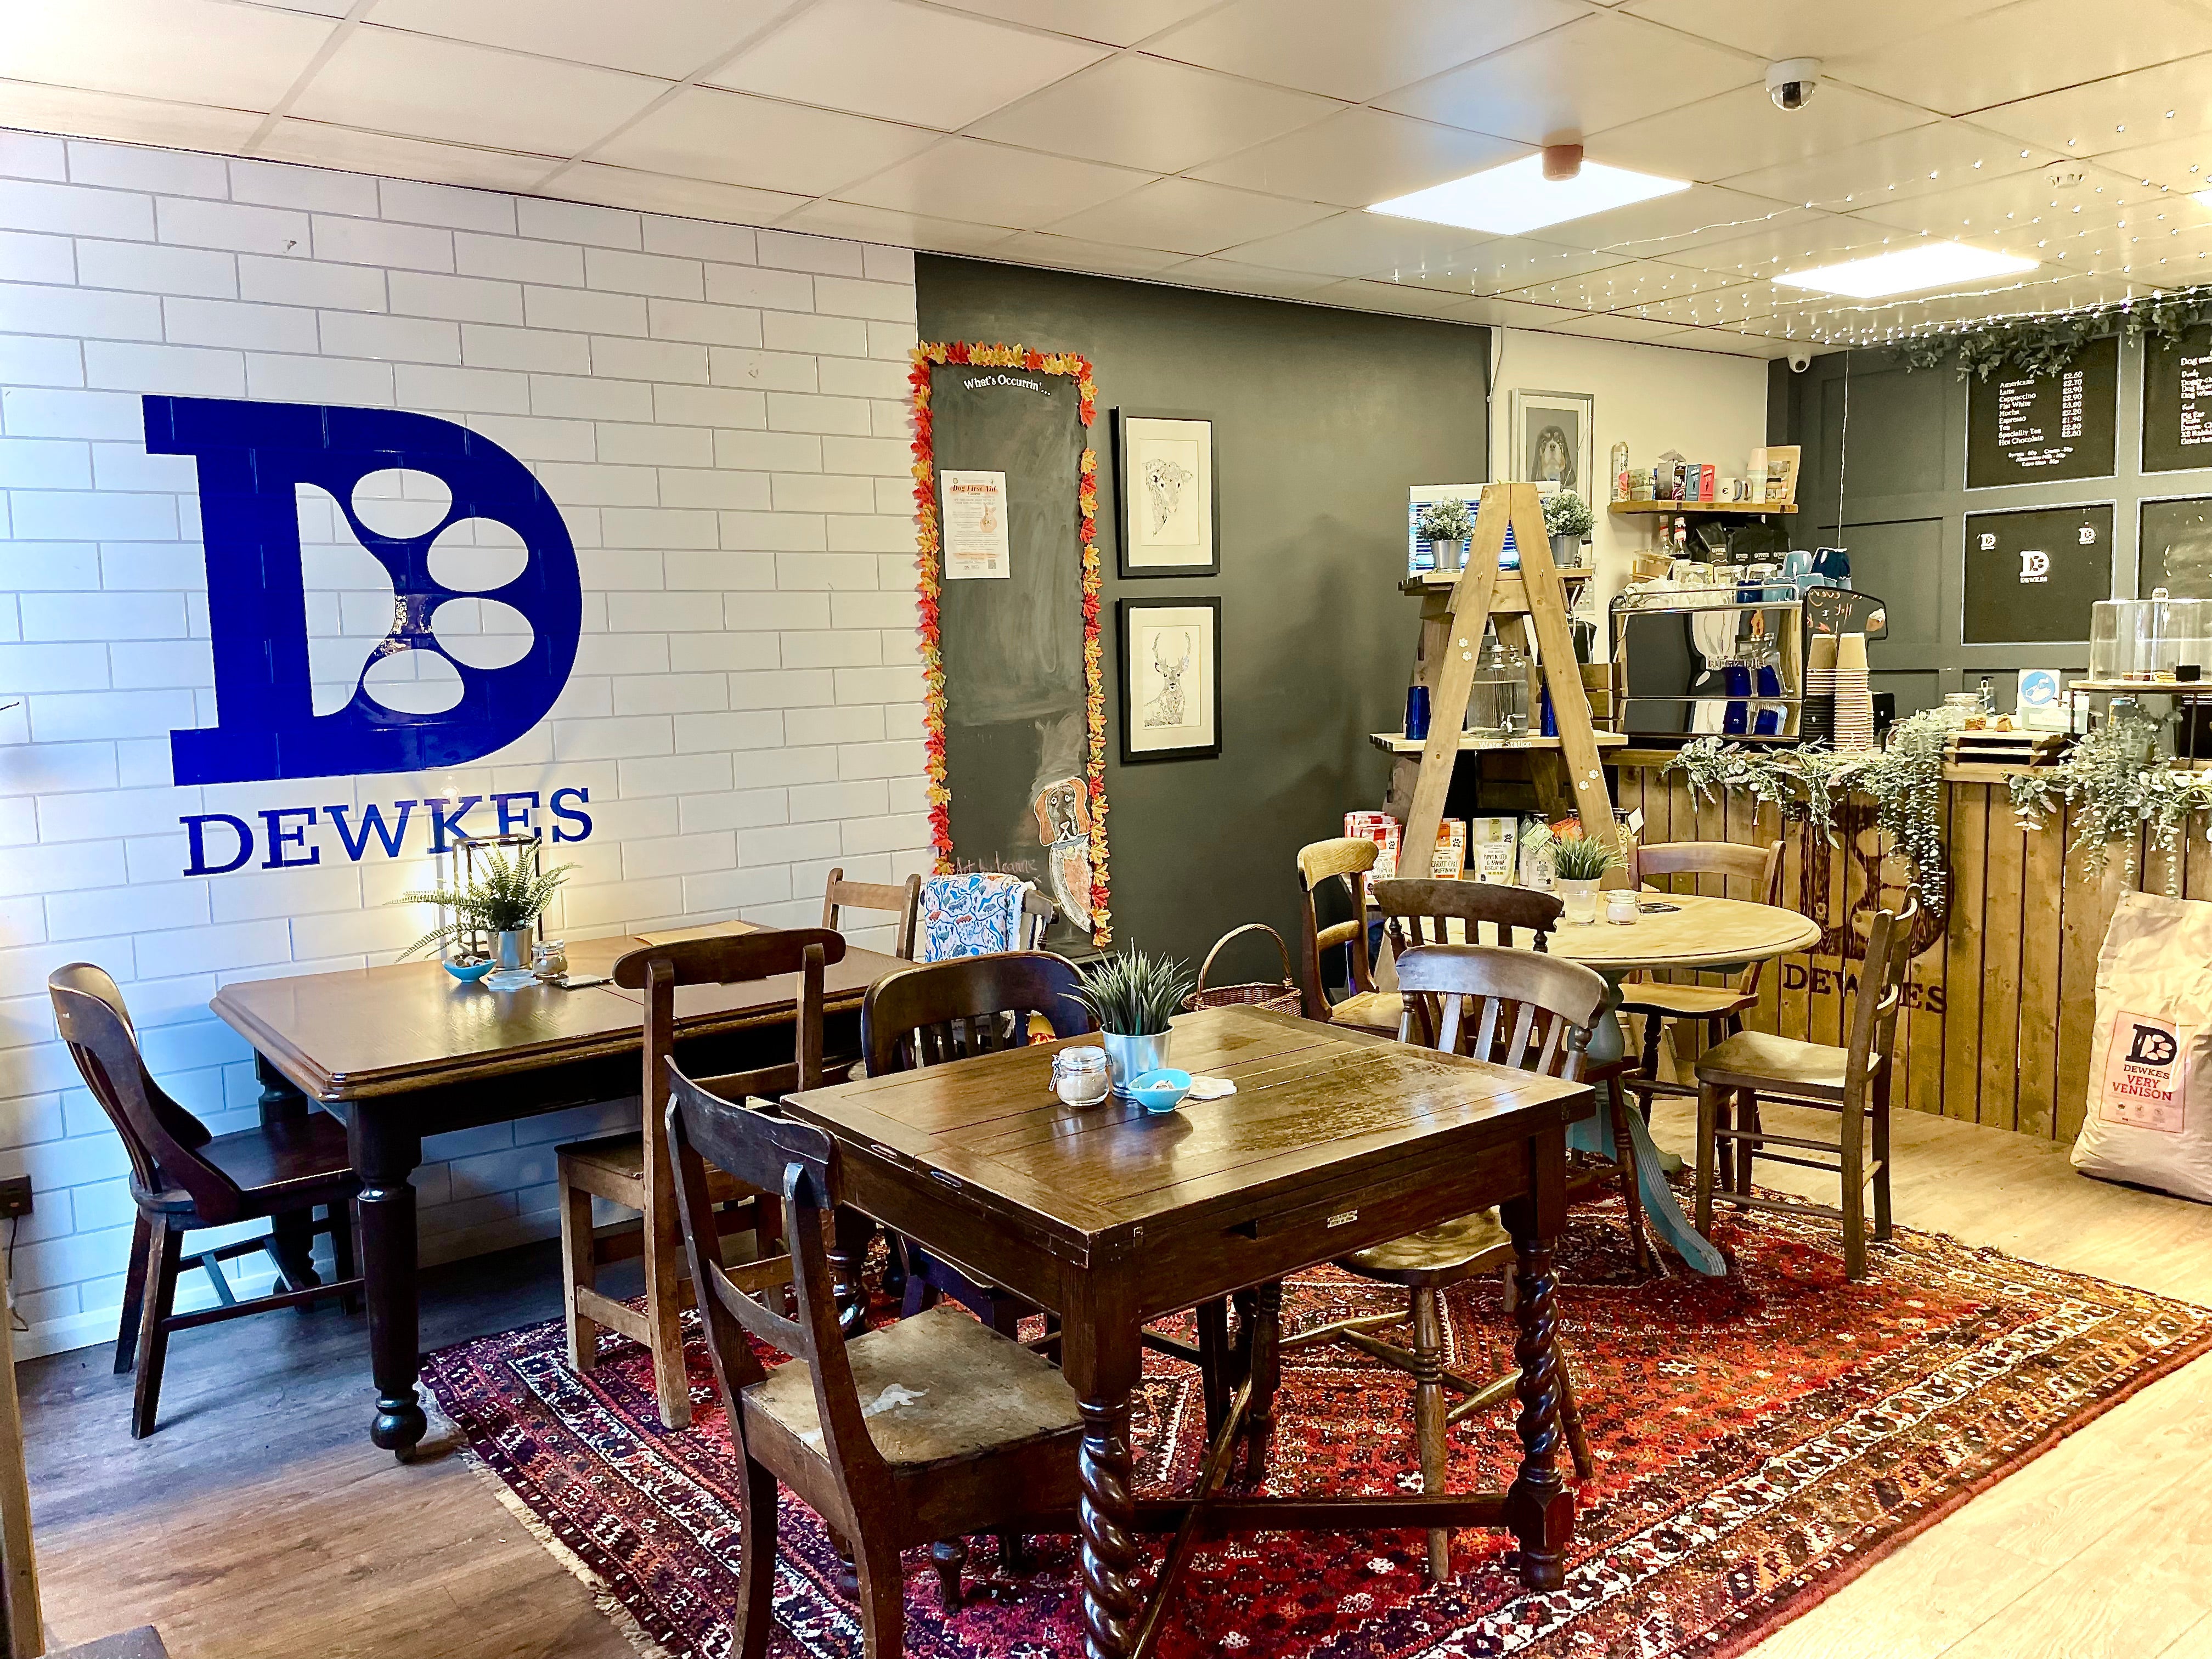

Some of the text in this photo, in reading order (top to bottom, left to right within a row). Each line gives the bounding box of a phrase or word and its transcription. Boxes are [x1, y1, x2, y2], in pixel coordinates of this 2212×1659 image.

[963, 375, 996, 390] What's
[1999, 380, 2035, 388] Americano
[1999, 393, 2037, 403] Cappuccino
[1999, 416, 2027, 424] Espresso
[2011, 436, 2044, 444] Chocolate
[1505, 740, 1532, 748] Station
[179, 787, 593, 877] DEWKES
[957, 856, 975, 874] Art
[1783, 963, 1948, 1014] DEWES
[2124, 1064, 2170, 1080] DEWKES
[2127, 1074, 2161, 1088] VERY
[2112, 1082, 2173, 1102] VENISON
